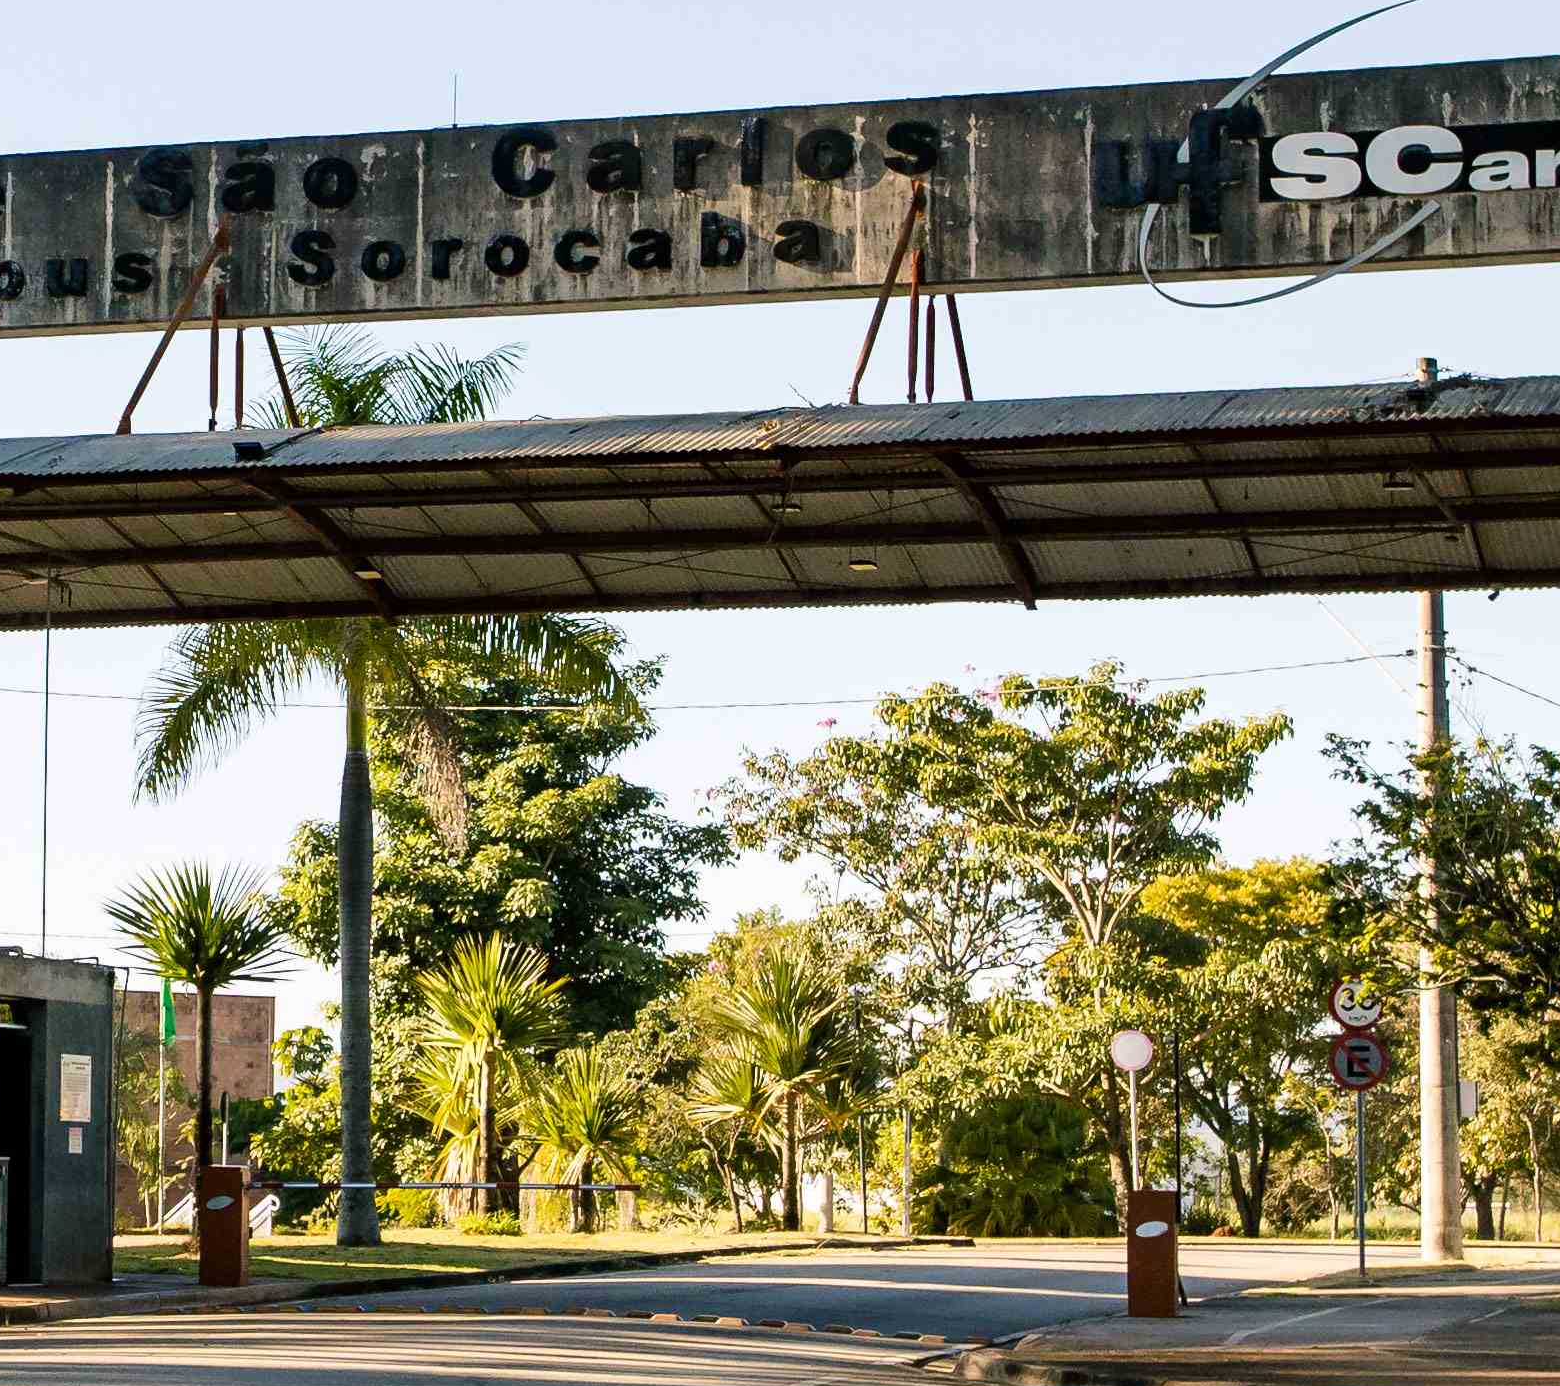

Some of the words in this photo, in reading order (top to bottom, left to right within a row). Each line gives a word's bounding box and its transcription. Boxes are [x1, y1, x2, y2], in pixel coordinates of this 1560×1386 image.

[133, 142, 357, 217] São
[492, 116, 941, 199] Carlos
[287, 213, 822, 287] Sorocaba
